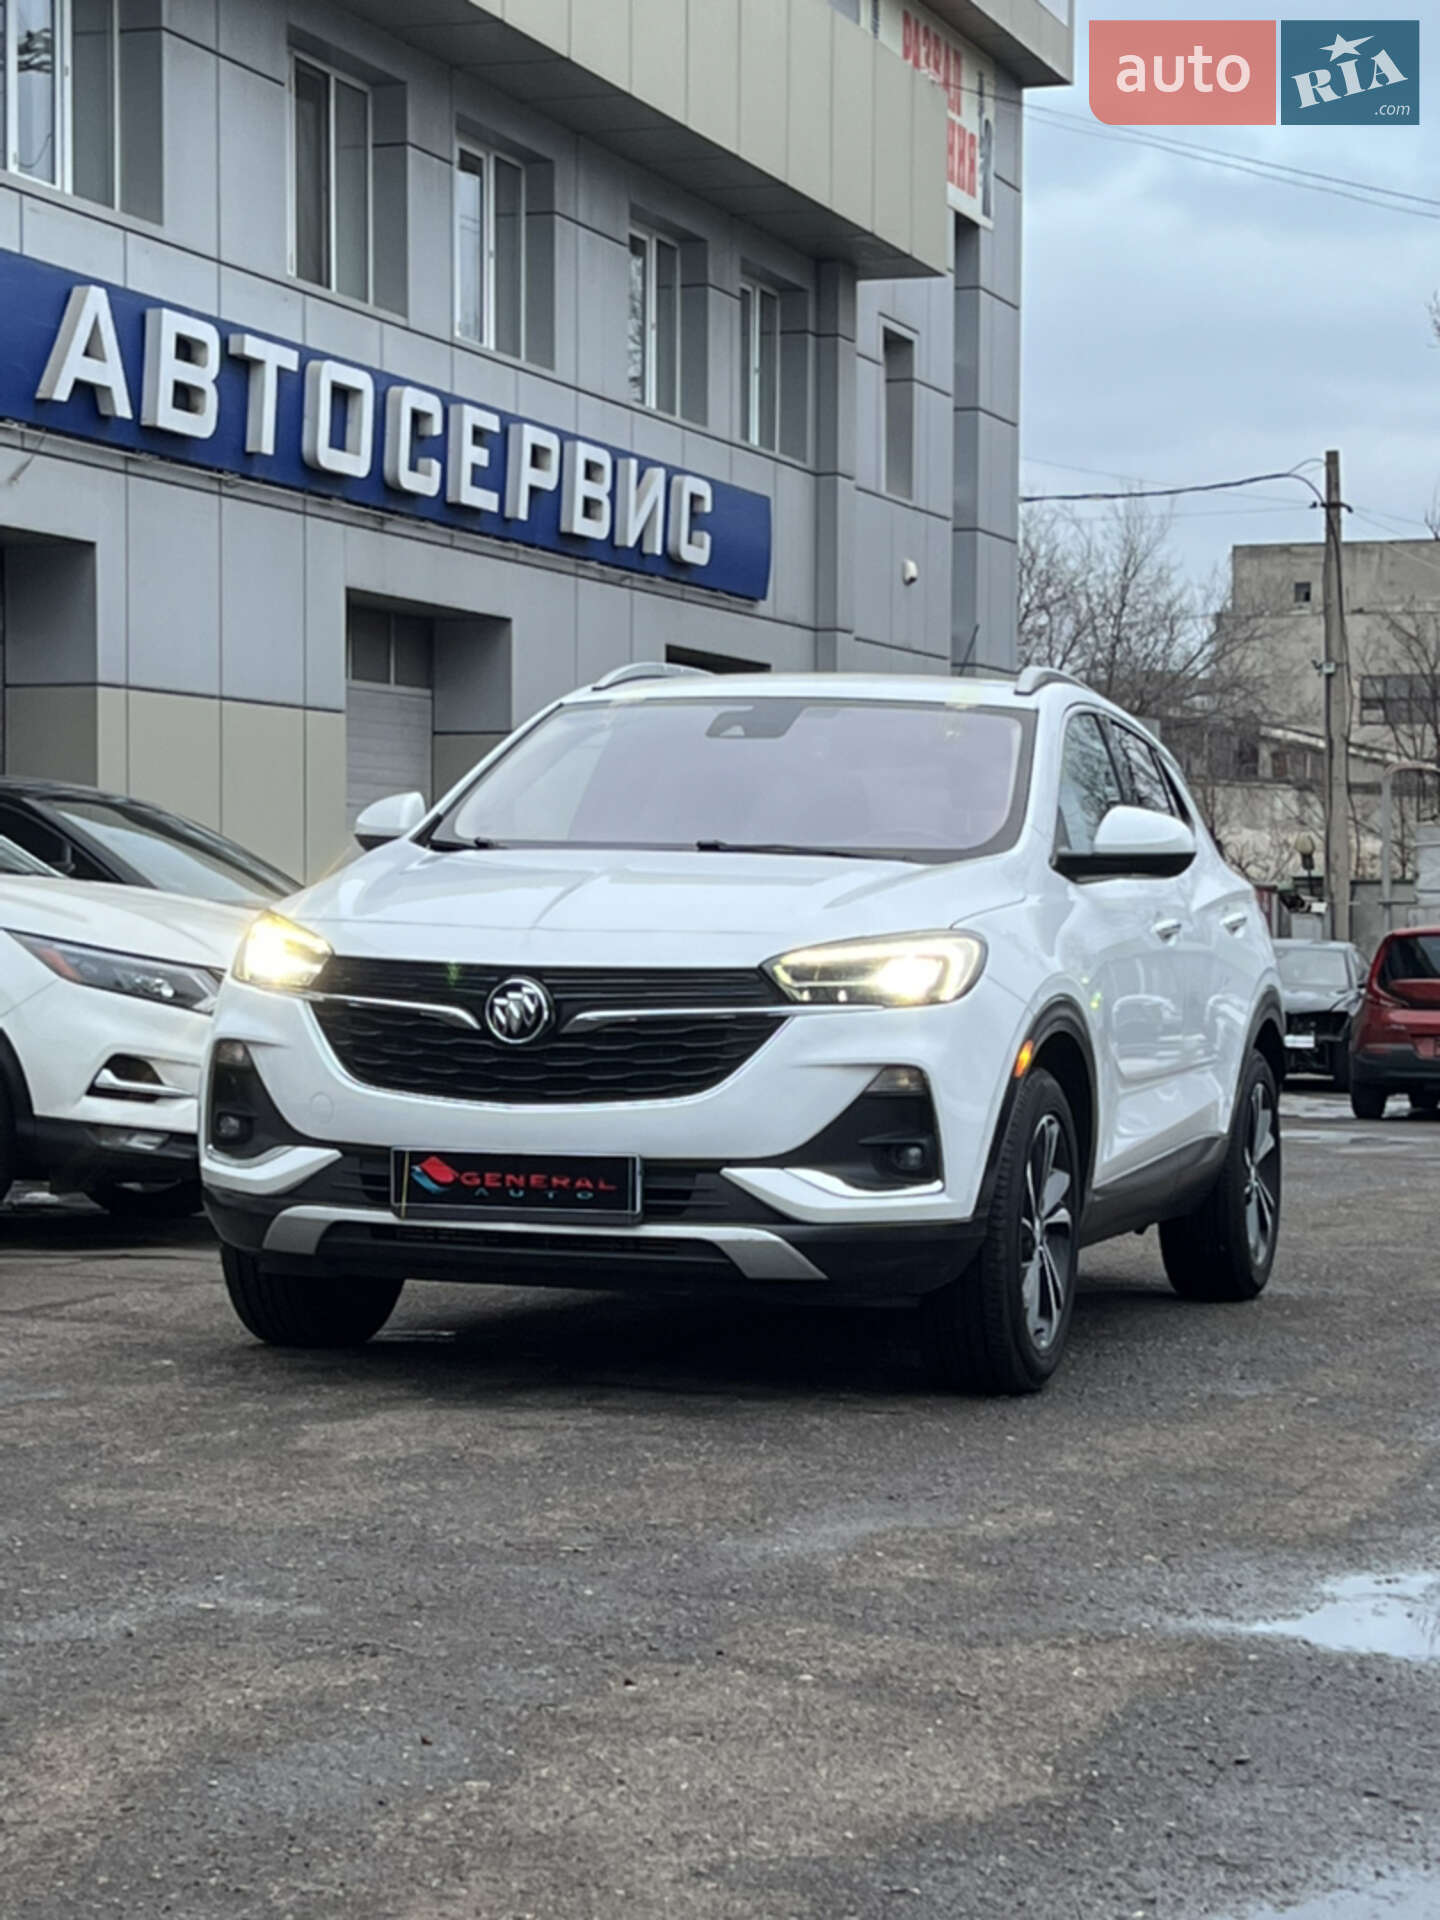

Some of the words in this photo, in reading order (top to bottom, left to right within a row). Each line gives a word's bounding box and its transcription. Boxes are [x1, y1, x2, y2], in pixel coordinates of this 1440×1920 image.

[35, 284, 713, 567] АВТОСЕРВИС
[460, 1171, 618, 1191] GENERAL
[474, 1187, 594, 1200] AUTO
